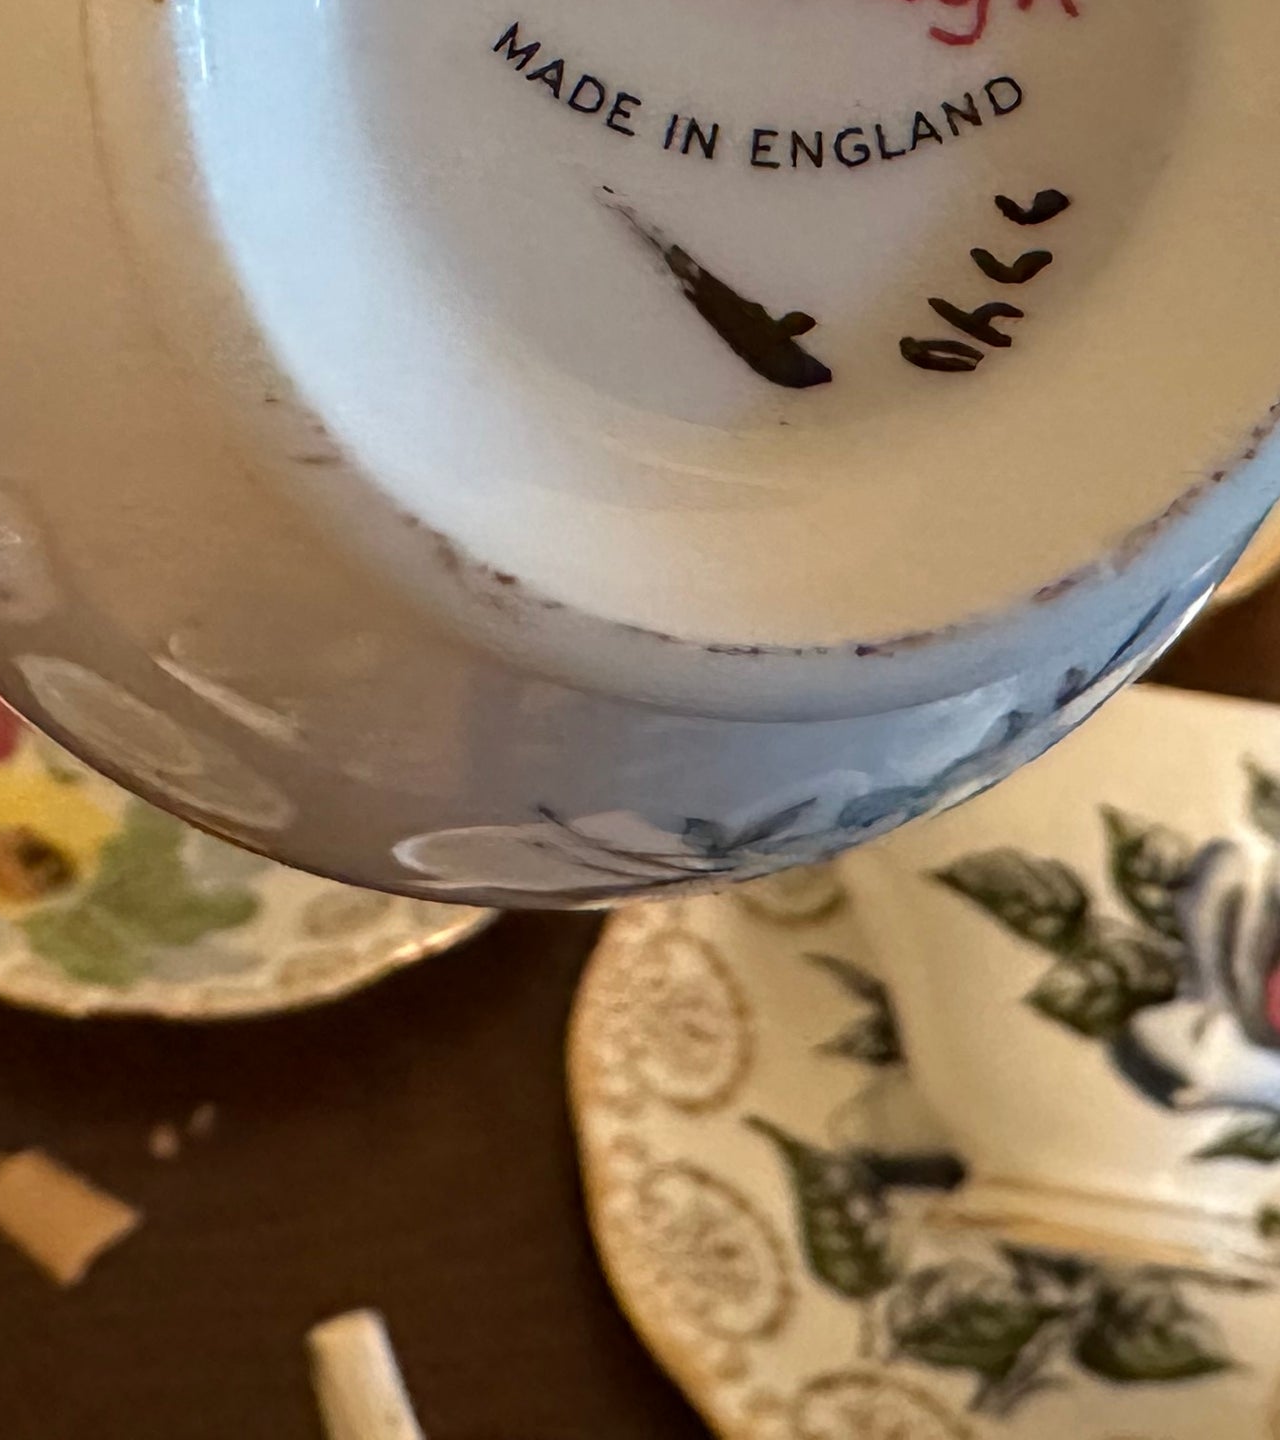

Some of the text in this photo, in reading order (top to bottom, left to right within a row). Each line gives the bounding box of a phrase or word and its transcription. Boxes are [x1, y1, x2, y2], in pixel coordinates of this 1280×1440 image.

[491, 21, 1024, 170] MADE IN ENGLAND
